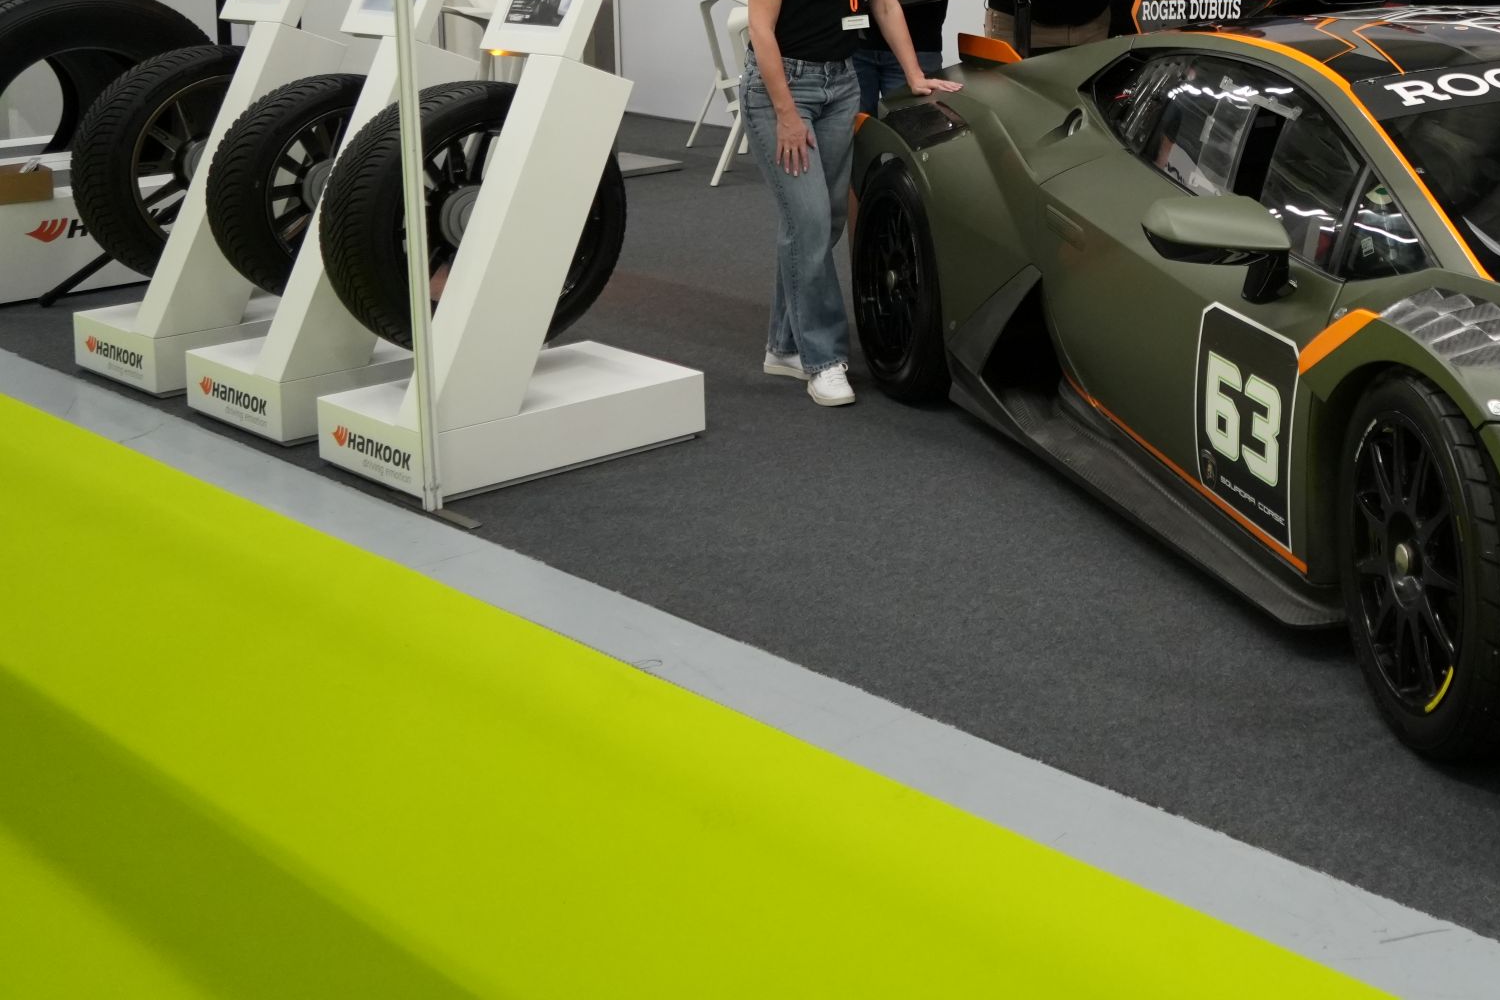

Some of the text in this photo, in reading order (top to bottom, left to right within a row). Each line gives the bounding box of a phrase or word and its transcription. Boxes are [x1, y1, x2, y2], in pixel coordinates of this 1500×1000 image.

[1142, 0, 1187, 21] ROGER
[1205, 350, 1282, 488] 63
[1257, 501, 1286, 527] CORSE
